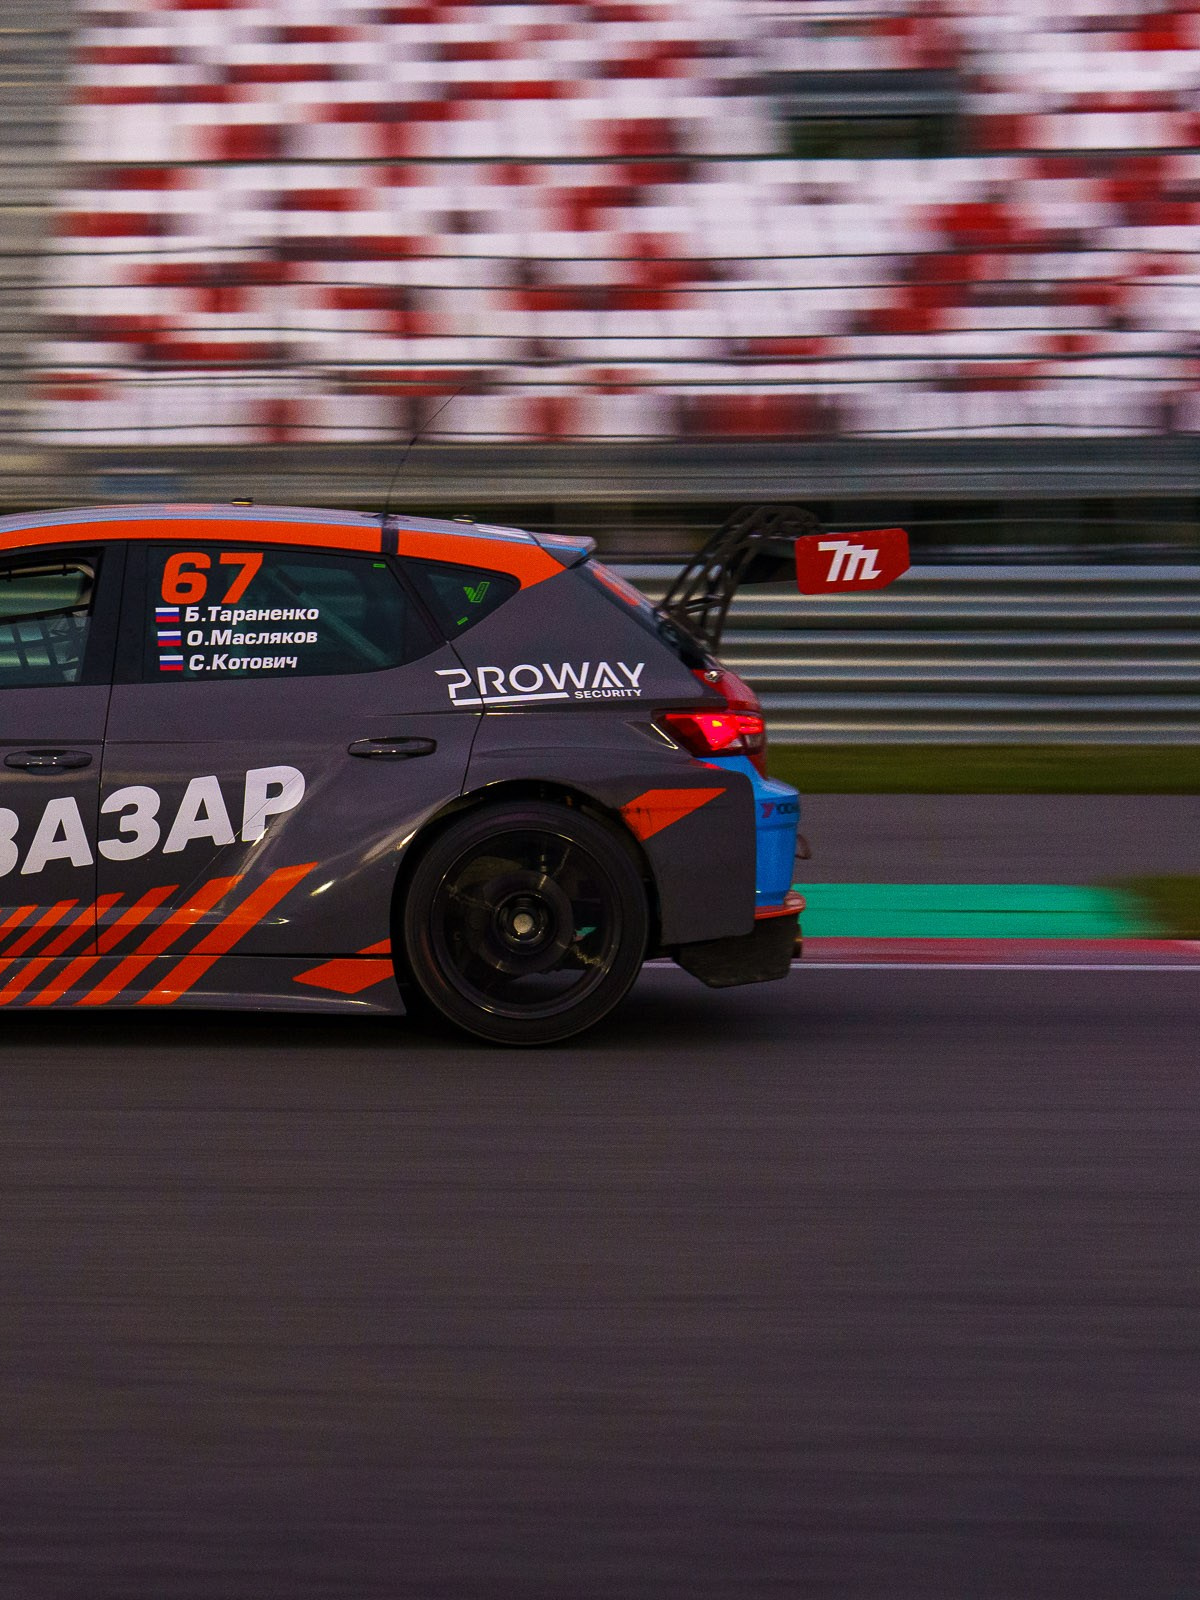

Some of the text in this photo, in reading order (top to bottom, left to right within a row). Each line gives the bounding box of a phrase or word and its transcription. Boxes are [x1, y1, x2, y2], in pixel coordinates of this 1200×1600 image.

[161, 551, 264, 605] 67
[184, 606, 320, 625] Б.Тараненко
[186, 629, 318, 646] О.Масляков
[189, 653, 298, 671] С.Котович
[434, 661, 645, 699] PROWAY
[574, 688, 642, 700] SECURITY
